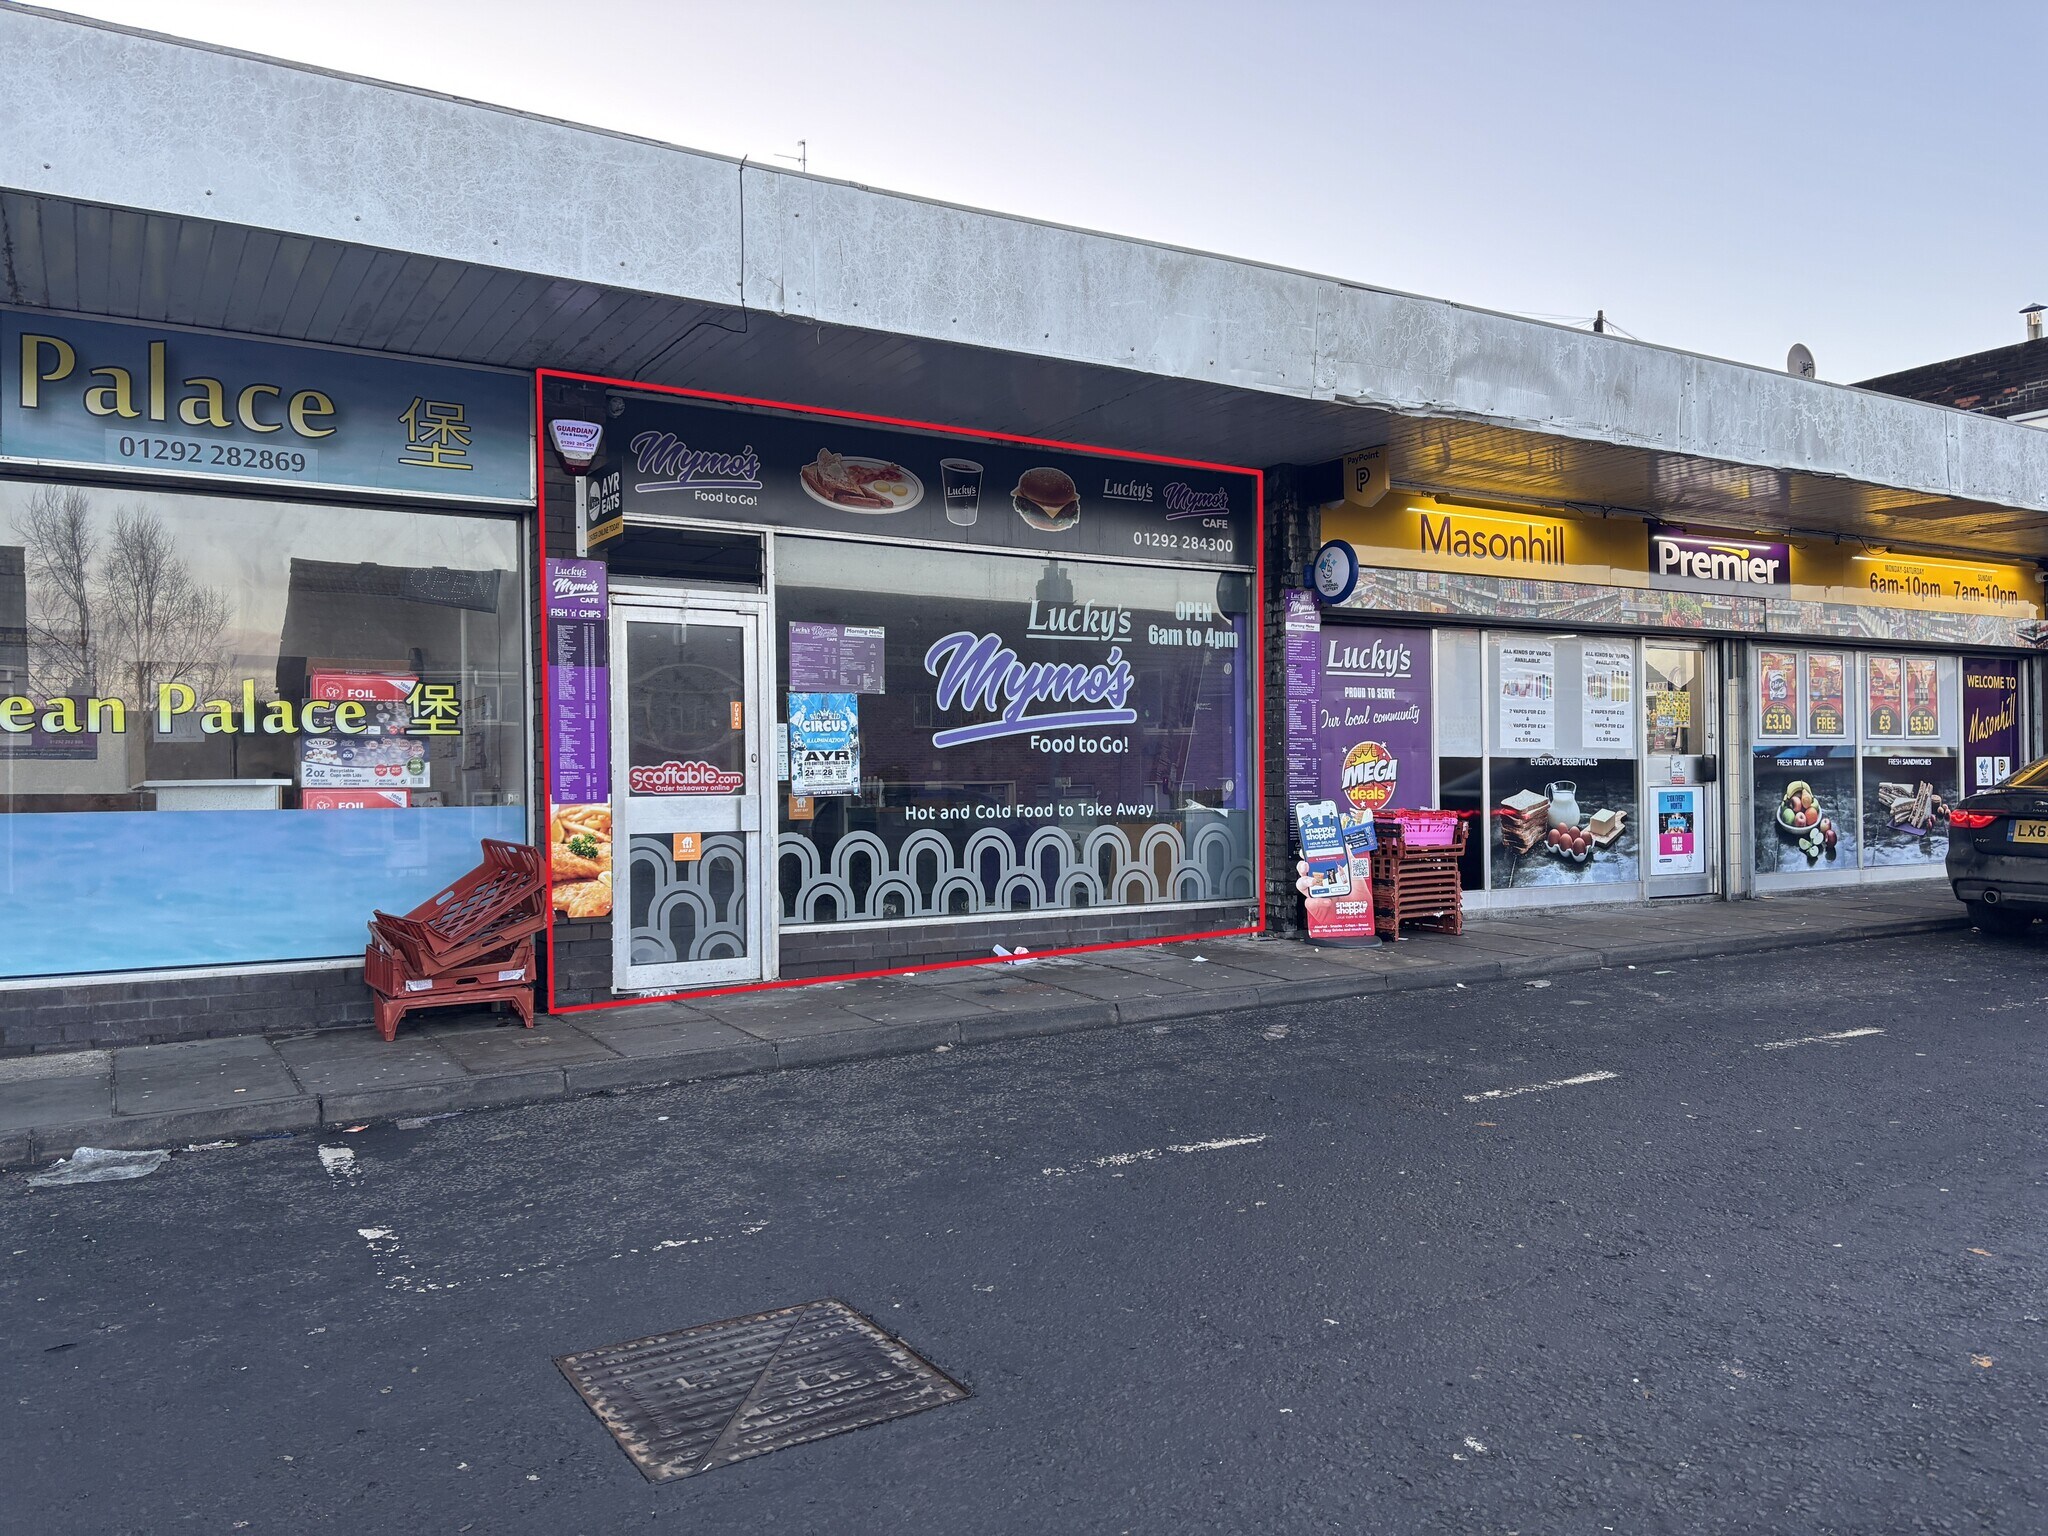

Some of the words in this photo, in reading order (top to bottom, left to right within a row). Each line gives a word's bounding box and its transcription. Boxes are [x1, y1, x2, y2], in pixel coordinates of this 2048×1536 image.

[19, 332, 336, 438] Palace
[398, 396, 473, 470] 堡
[556, 425, 593, 435] GUARDIAN
[119, 437, 203, 463] 01292
[210, 444, 306, 472] 282869
[630, 431, 761, 482] Mymo's
[1347, 450, 1380, 465] PayPoint
[601, 472, 620, 497] AYR
[947, 484, 977, 496] Lucky's
[601, 493, 620, 514] EATS
[694, 490, 723, 502] Food
[725, 493, 738, 504] to
[738, 495, 758, 506] Go!
[1103, 479, 1153, 501] Lucky's
[1163, 482, 1229, 513] Mymo's
[1202, 518, 1228, 529] CAFE
[1133, 532, 1178, 548] 01292
[1182, 536, 1233, 552] 284300
[1420, 514, 1565, 566] Masonhill
[555, 566, 587, 577] Lucky's
[1658, 541, 1780, 585] Premier
[410, 568, 491, 598] OPEN
[1977, 573, 1993, 582] SUNDAY
[552, 578, 599, 595] Mymo's
[1869, 572, 1941, 602] 6am-10pm
[1953, 580, 2018, 609] 7am-10pm
[550, 608, 568, 617] FISH
[579, 609, 601, 618] CHIPS
[1027, 599, 1132, 641] Lucky's
[1175, 601, 1213, 622] OPEN
[1148, 624, 1183, 646] 6am
[1185, 627, 1202, 646] to
[1205, 627, 1239, 649] 4pm
[1326, 639, 1411, 677] Lucky's
[924, 631, 1135, 722] Mymo's
[1967, 674, 2005, 689] WELCOME
[2005, 676, 2017, 690] TO
[347, 689, 376, 698] FOIL
[1344, 687, 1366, 698] PROUD
[1367, 687, 1376, 699] TO
[1376, 688, 1396, 699] SERVE
[0, 696, 126, 734] ean
[157, 679, 367, 734] Palace
[406, 682, 463, 736] 堡
[1344, 705, 1370, 726] local
[1373, 704, 1420, 724] community
[802, 720, 848, 732] CIRCUS
[1766, 713, 1792, 730] £3.19
[1816, 716, 1837, 730] FREE
[1879, 714, 1891, 730] £3
[1910, 716, 1934, 732] £5.50
[1968, 692, 2016, 744] Masonhill
[1030, 735, 1075, 753] Food
[1079, 736, 1099, 753] to
[1100, 736, 1129, 753] Go!
[804, 751, 850, 762] AYR
[1530, 757, 1561, 766] EVERYDAY
[1562, 758, 1598, 766] ESSENTIALS
[1813, 759, 1825, 767] VEG
[1888, 758, 1902, 766] FRESH
[1902, 758, 1932, 766] SANDWICHES
[306, 768, 313, 778] 2
[632, 766, 741, 785] scoffable.com
[1341, 759, 1398, 790] MEGA
[676, 784, 709, 792] takeaway
[1350, 786, 1386, 800] deals
[905, 806, 935, 821] Hot
[940, 804, 970, 820] and
[975, 803, 1010, 819] Cold
[1016, 802, 1053, 818] Food
[1059, 803, 1074, 817] to
[1078, 802, 1112, 817] Take
[1116, 802, 1154, 818] Away
[1305, 826, 1332, 835] snappy
[1306, 833, 1336, 841] shopper
[2017, 824, 2048, 838] LX6
[1335, 901, 1363, 909] snappy
[1336, 907, 1366, 915] shopper
